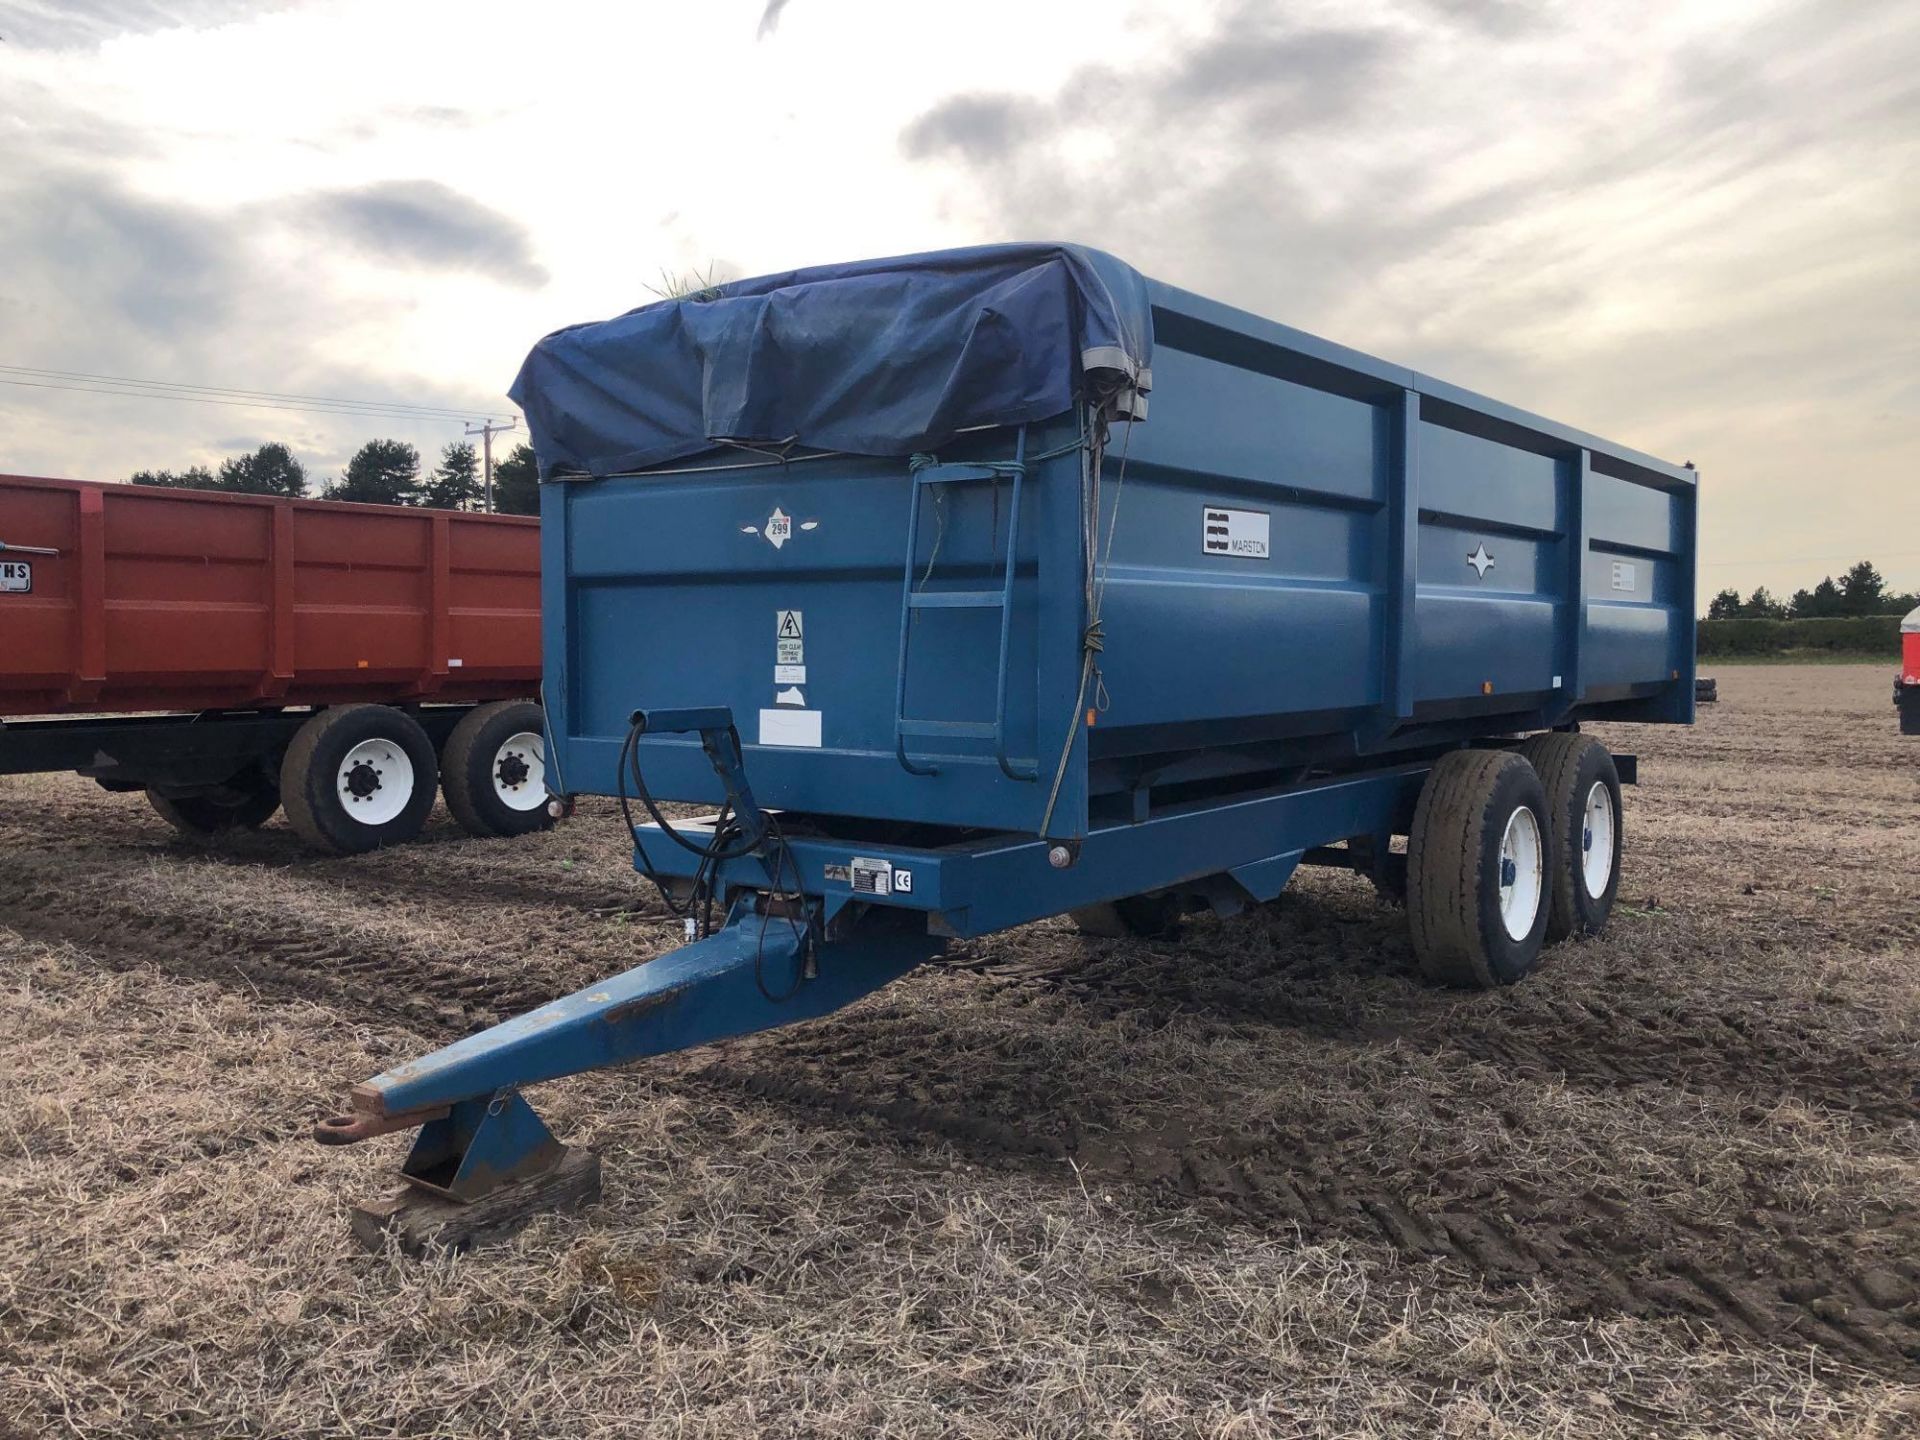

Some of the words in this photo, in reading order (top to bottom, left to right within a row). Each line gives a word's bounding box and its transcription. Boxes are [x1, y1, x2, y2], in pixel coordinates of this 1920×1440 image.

[772, 523, 788, 535] 299
[1232, 539, 1266, 554] MARSTON
[0, 564, 26, 578] HS
[896, 874, 909, 888] CE
